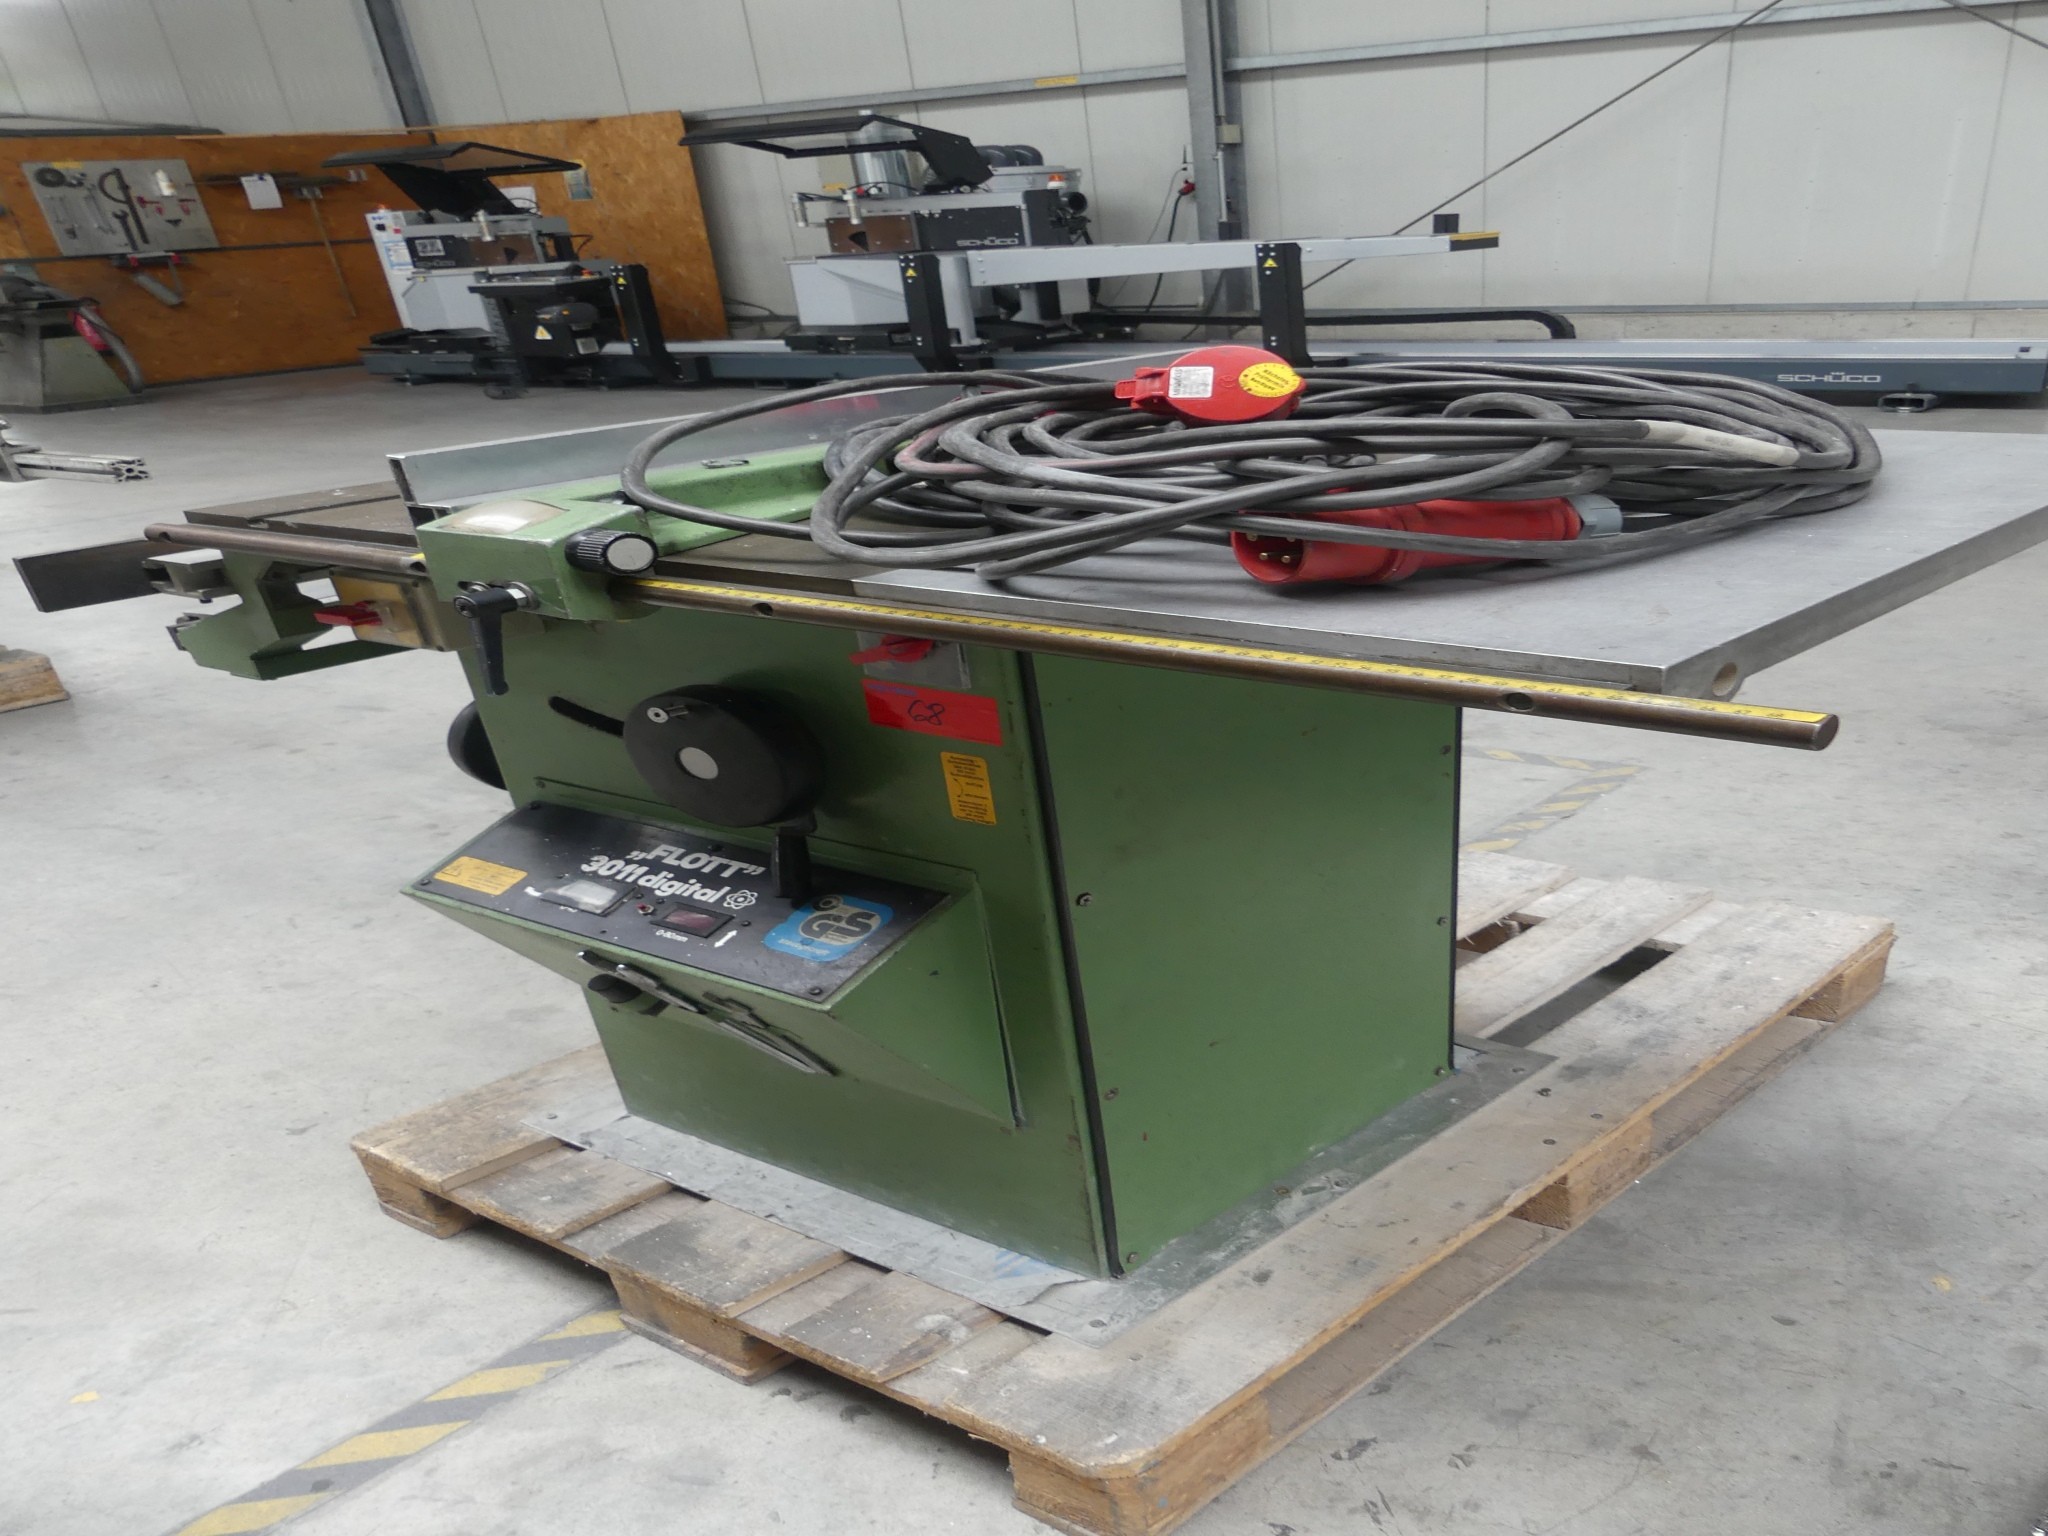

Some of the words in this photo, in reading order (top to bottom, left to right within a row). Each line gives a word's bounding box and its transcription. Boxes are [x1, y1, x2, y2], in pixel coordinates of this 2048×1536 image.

[957, 236, 1019, 247] SCHÜCO
[1777, 371, 1881, 383] SCHÜCO
[907, 699, 945, 726] 68
[580, 855, 649, 883] 3011
[637, 870, 731, 903] digital
